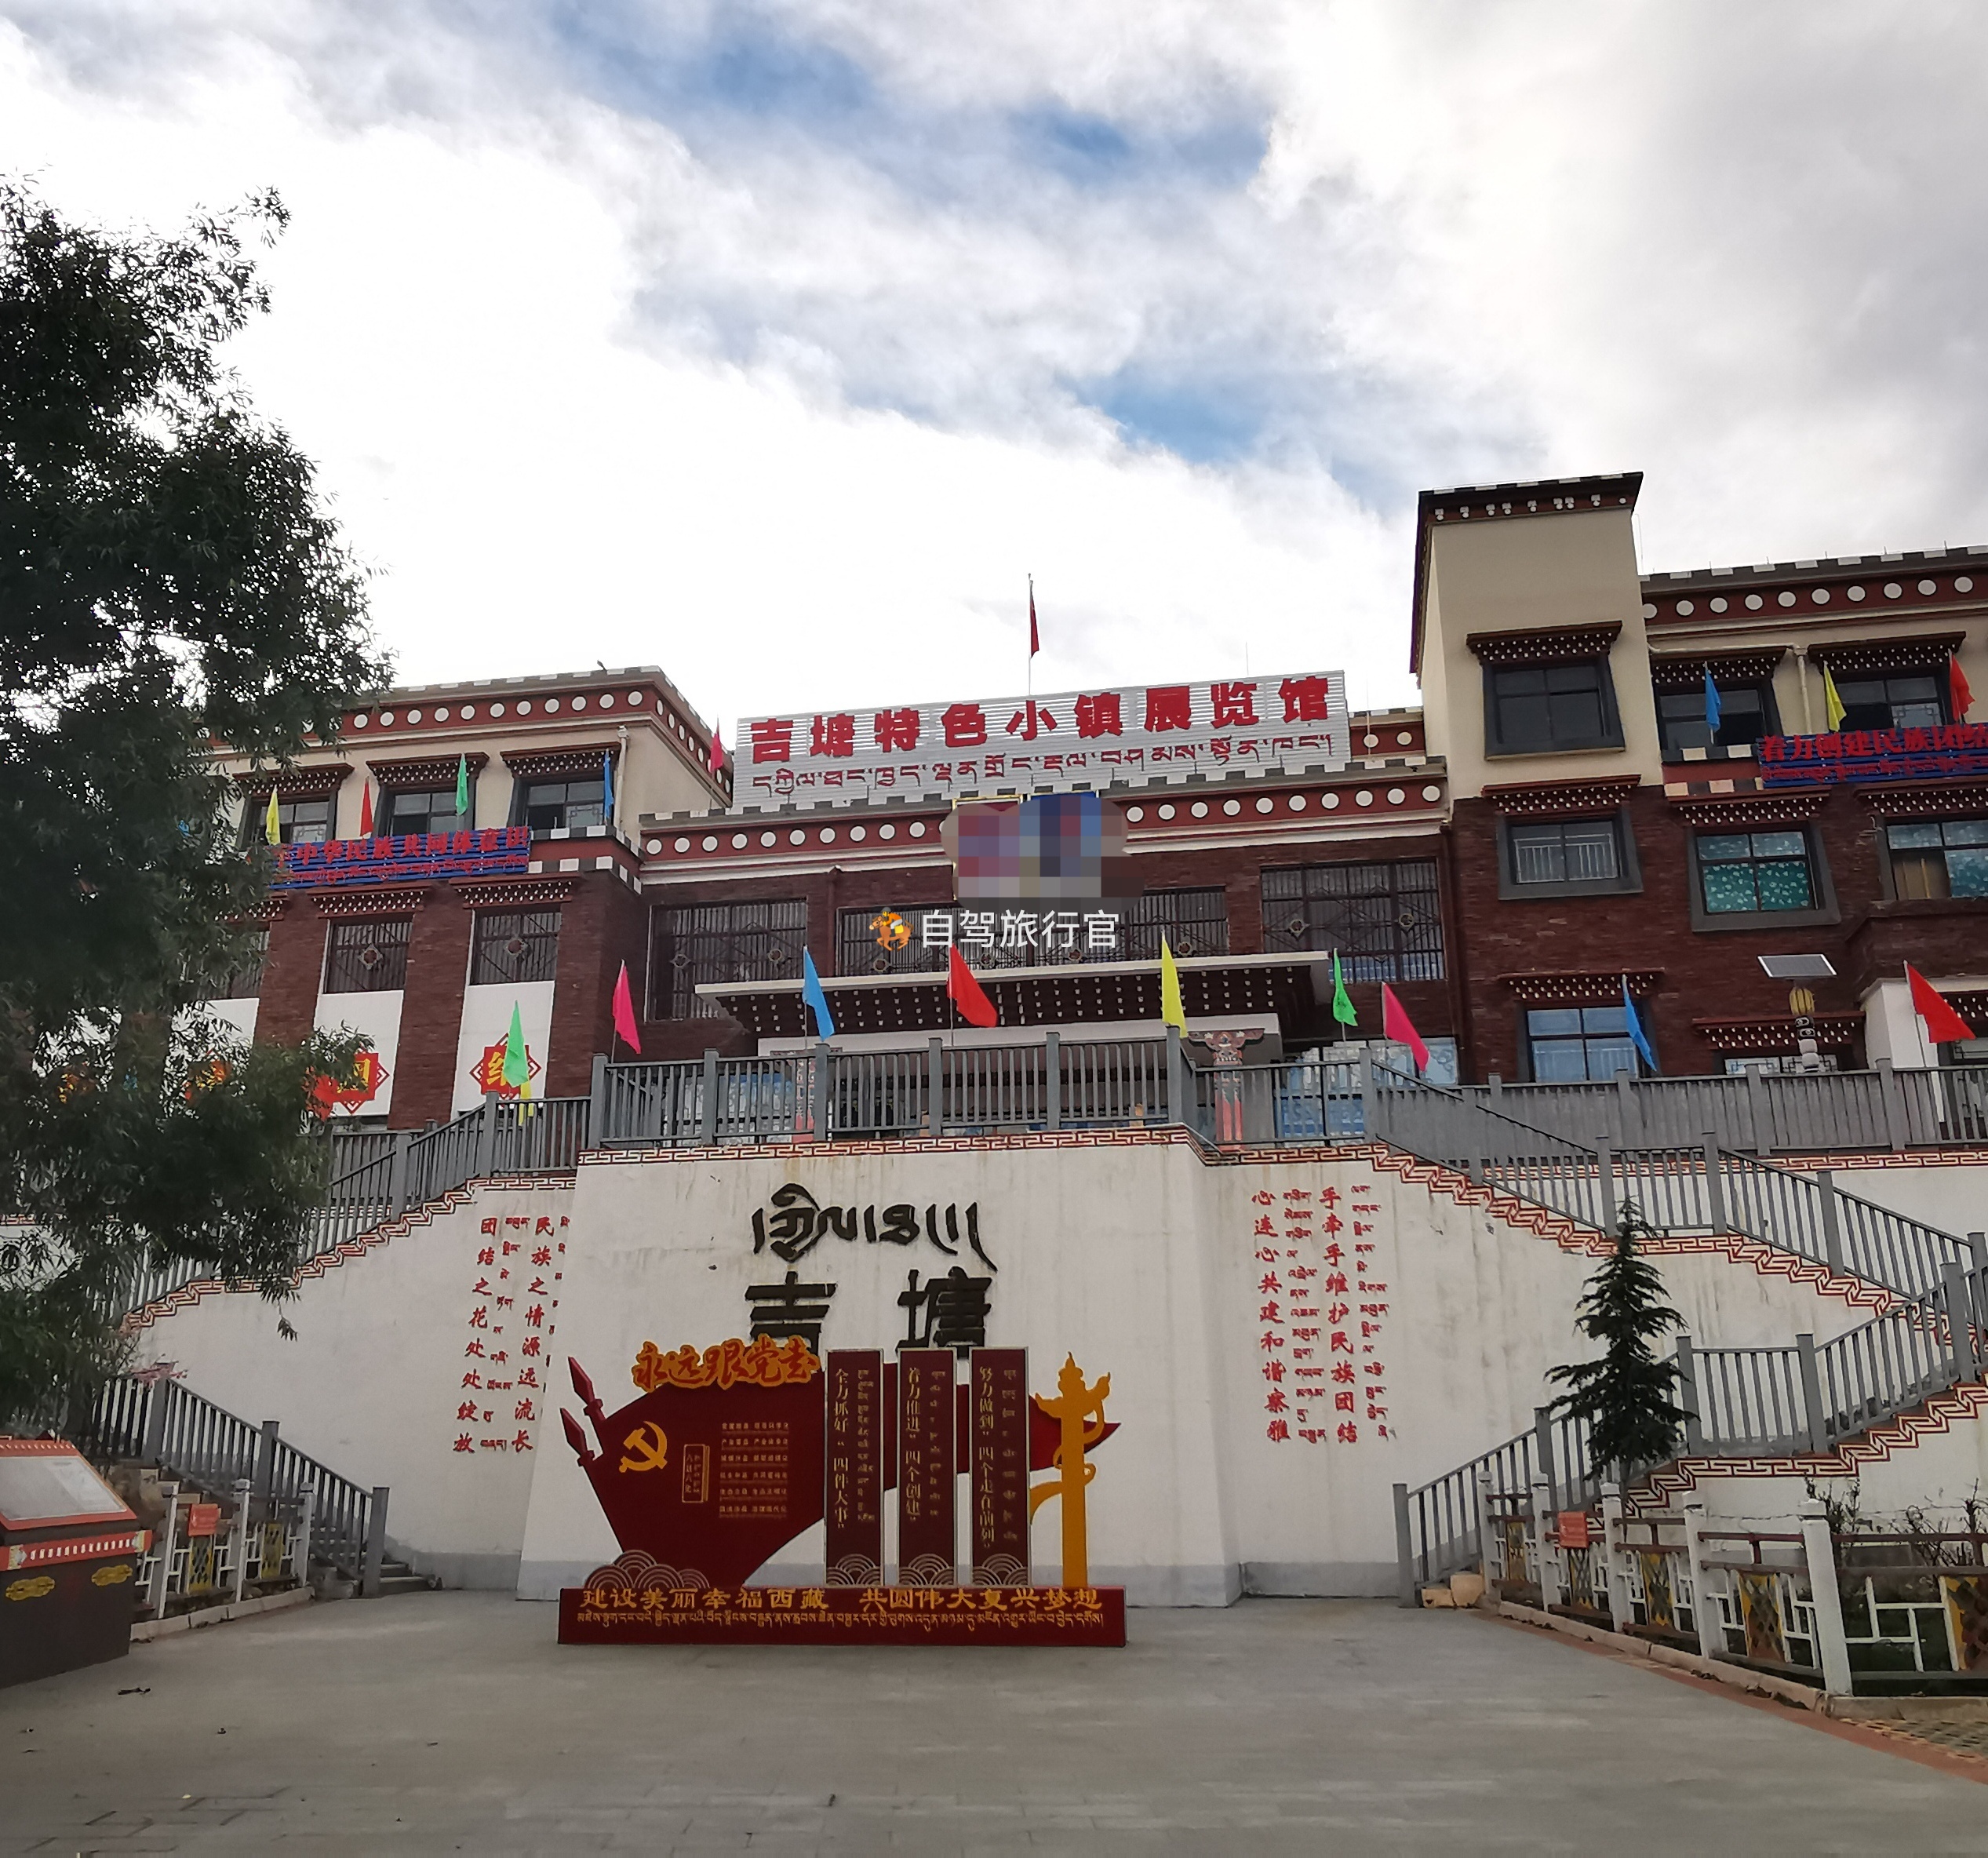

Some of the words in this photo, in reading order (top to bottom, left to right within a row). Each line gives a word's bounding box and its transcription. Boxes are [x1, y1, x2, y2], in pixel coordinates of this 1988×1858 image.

[751, 676, 1329, 763] 吉塘特色小镇展览馆
[512, 1216, 554, 1452] 民族之情源远流长
[631, 1333, 821, 1393] 永远跟党走
[579, 1587, 829, 1609] 建设美丽幸福西藏
[859, 1587, 1102, 1611] 共圆伟大复兴梦想
